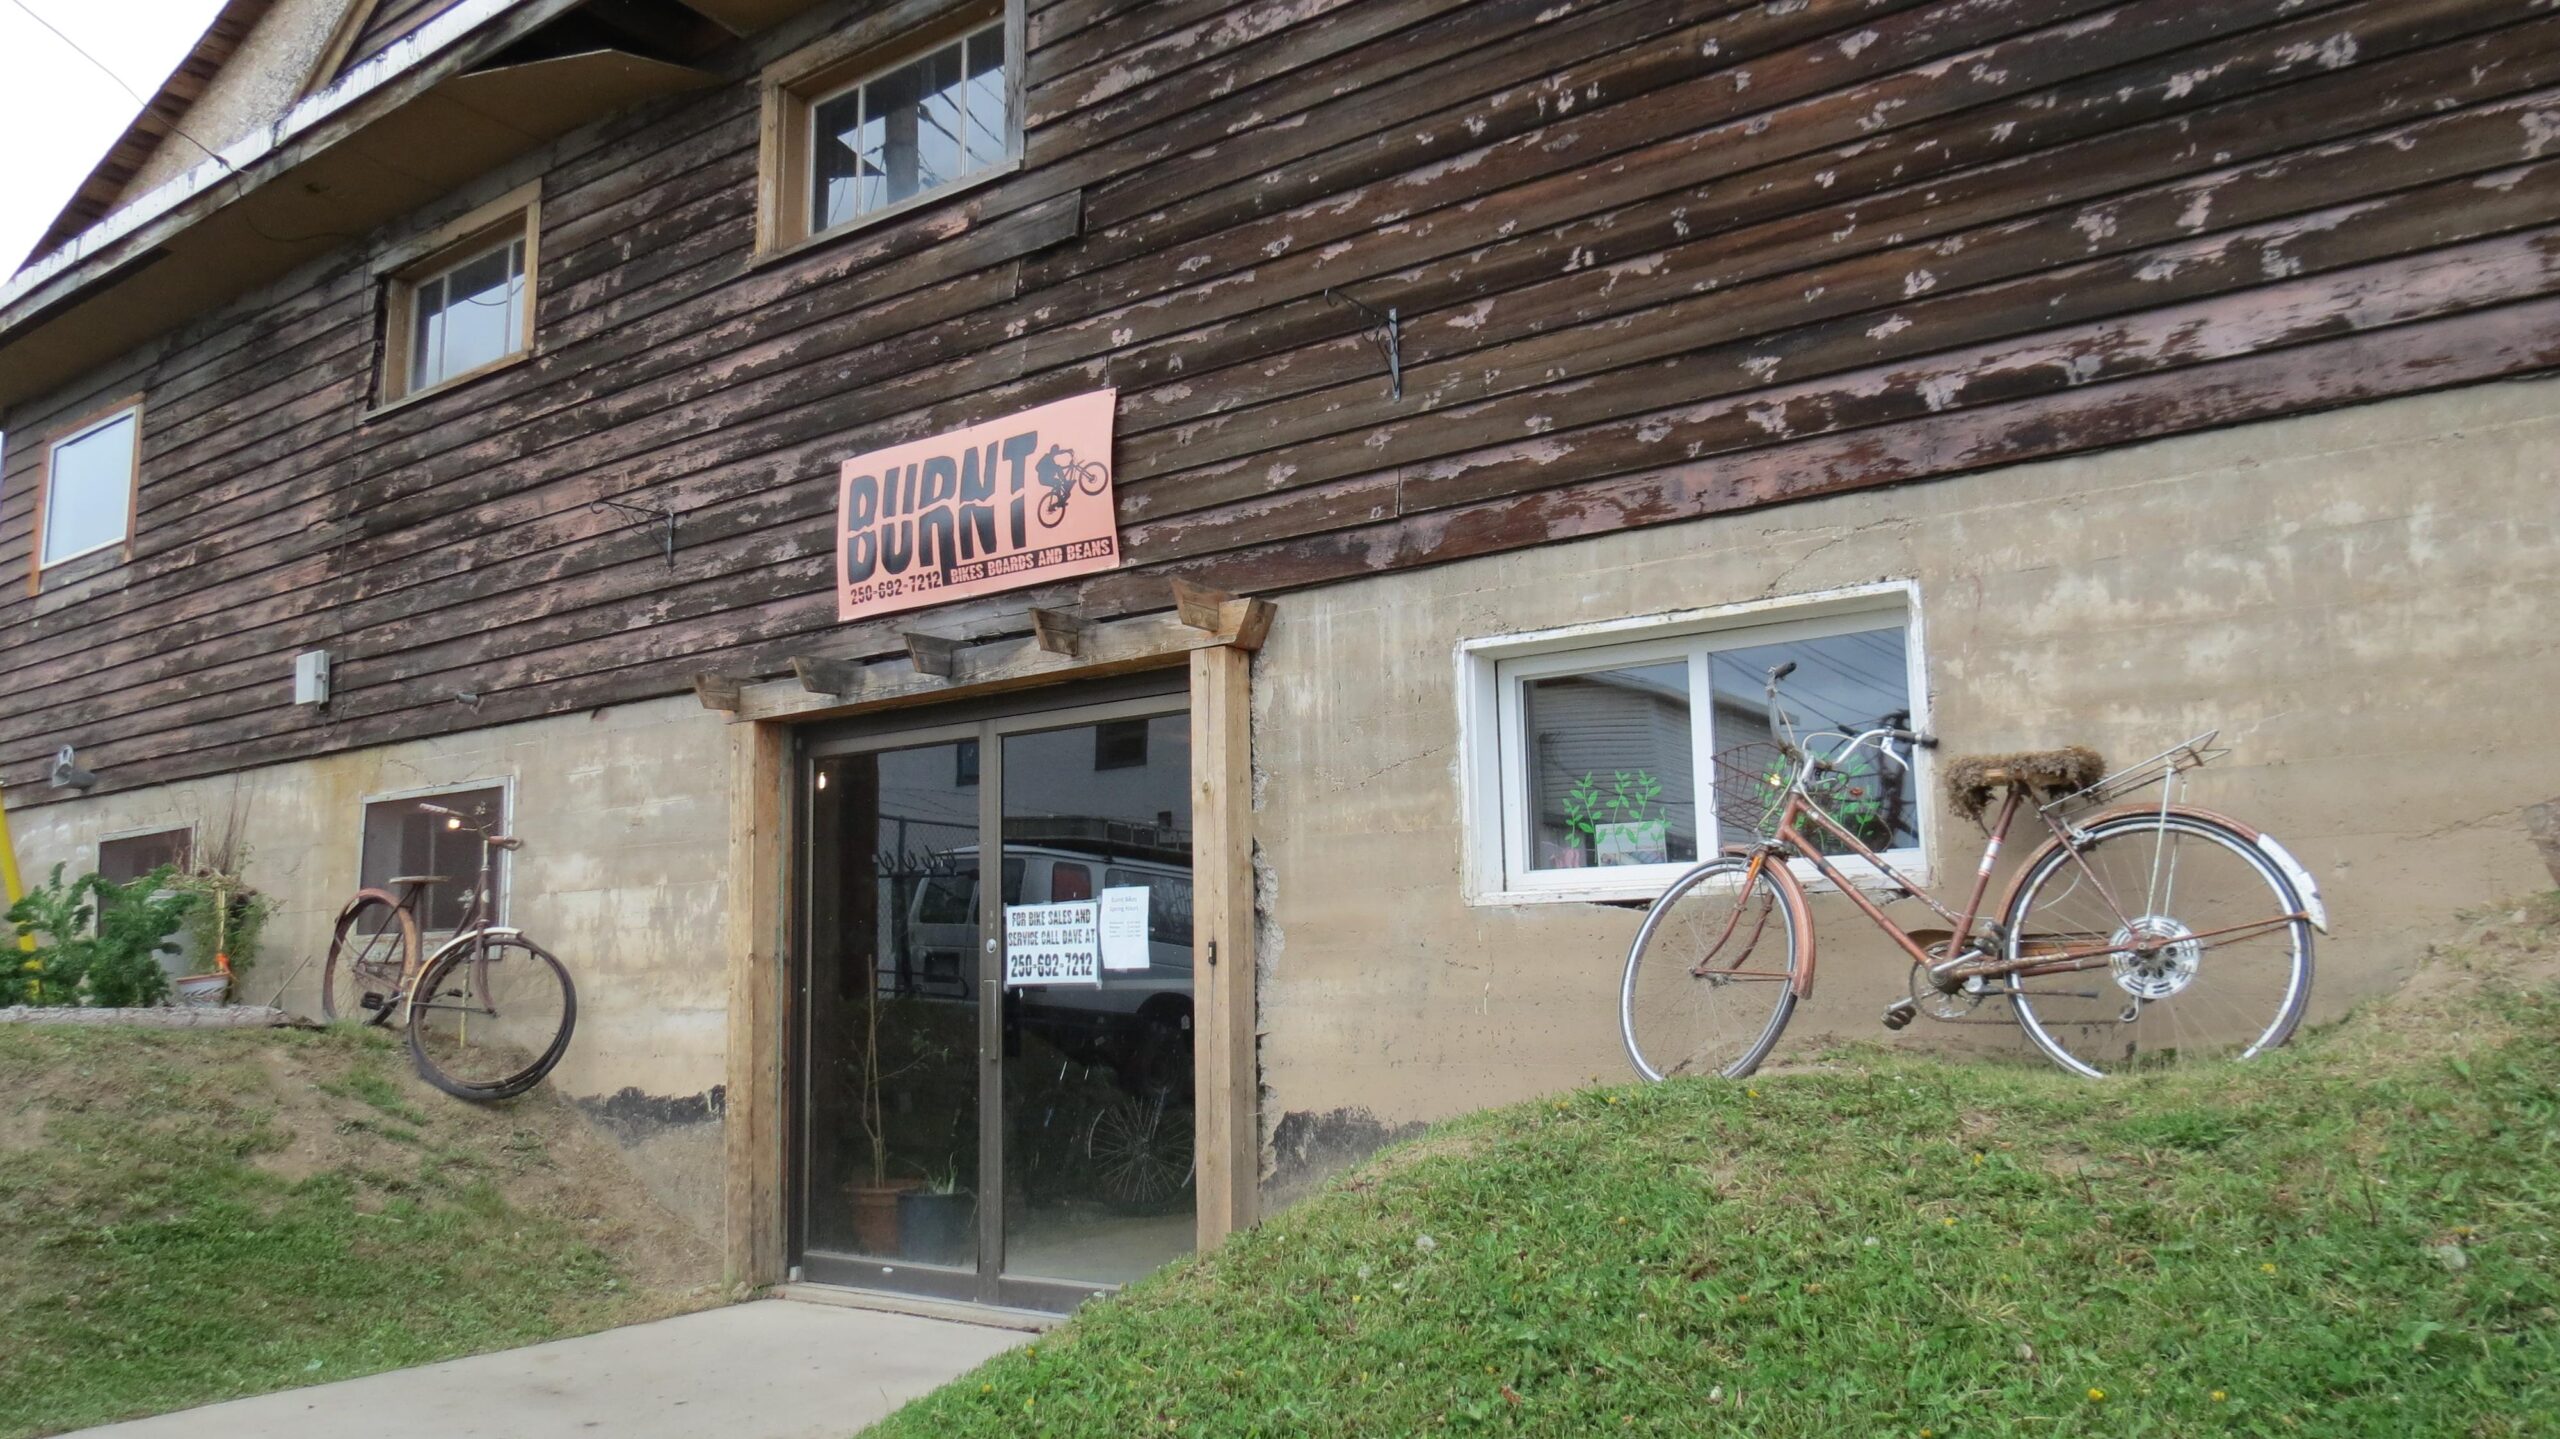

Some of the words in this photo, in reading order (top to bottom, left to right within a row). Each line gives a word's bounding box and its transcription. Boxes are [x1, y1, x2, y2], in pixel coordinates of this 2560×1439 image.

[848, 431, 1038, 586] BURNT
[950, 562, 984, 584] BIKES
[988, 553, 1034, 575] BOARDS
[1038, 548, 1063, 566] AND
[1066, 540, 1111, 560] BEANS
[851, 571, 941, 605] 250-692-7212
[1012, 912, 1026, 927] FOR
[1028, 911, 1046, 927] BIKE
[1048, 909, 1072, 925] SALES
[1075, 908, 1091, 924] AND
[1008, 931, 1039, 946] SERVICE
[1041, 930, 1060, 945] CALL
[1062, 929, 1082, 945] DAVE
[1085, 928, 1095, 943] AT
[1011, 952, 1093, 978] 250-692-7212
